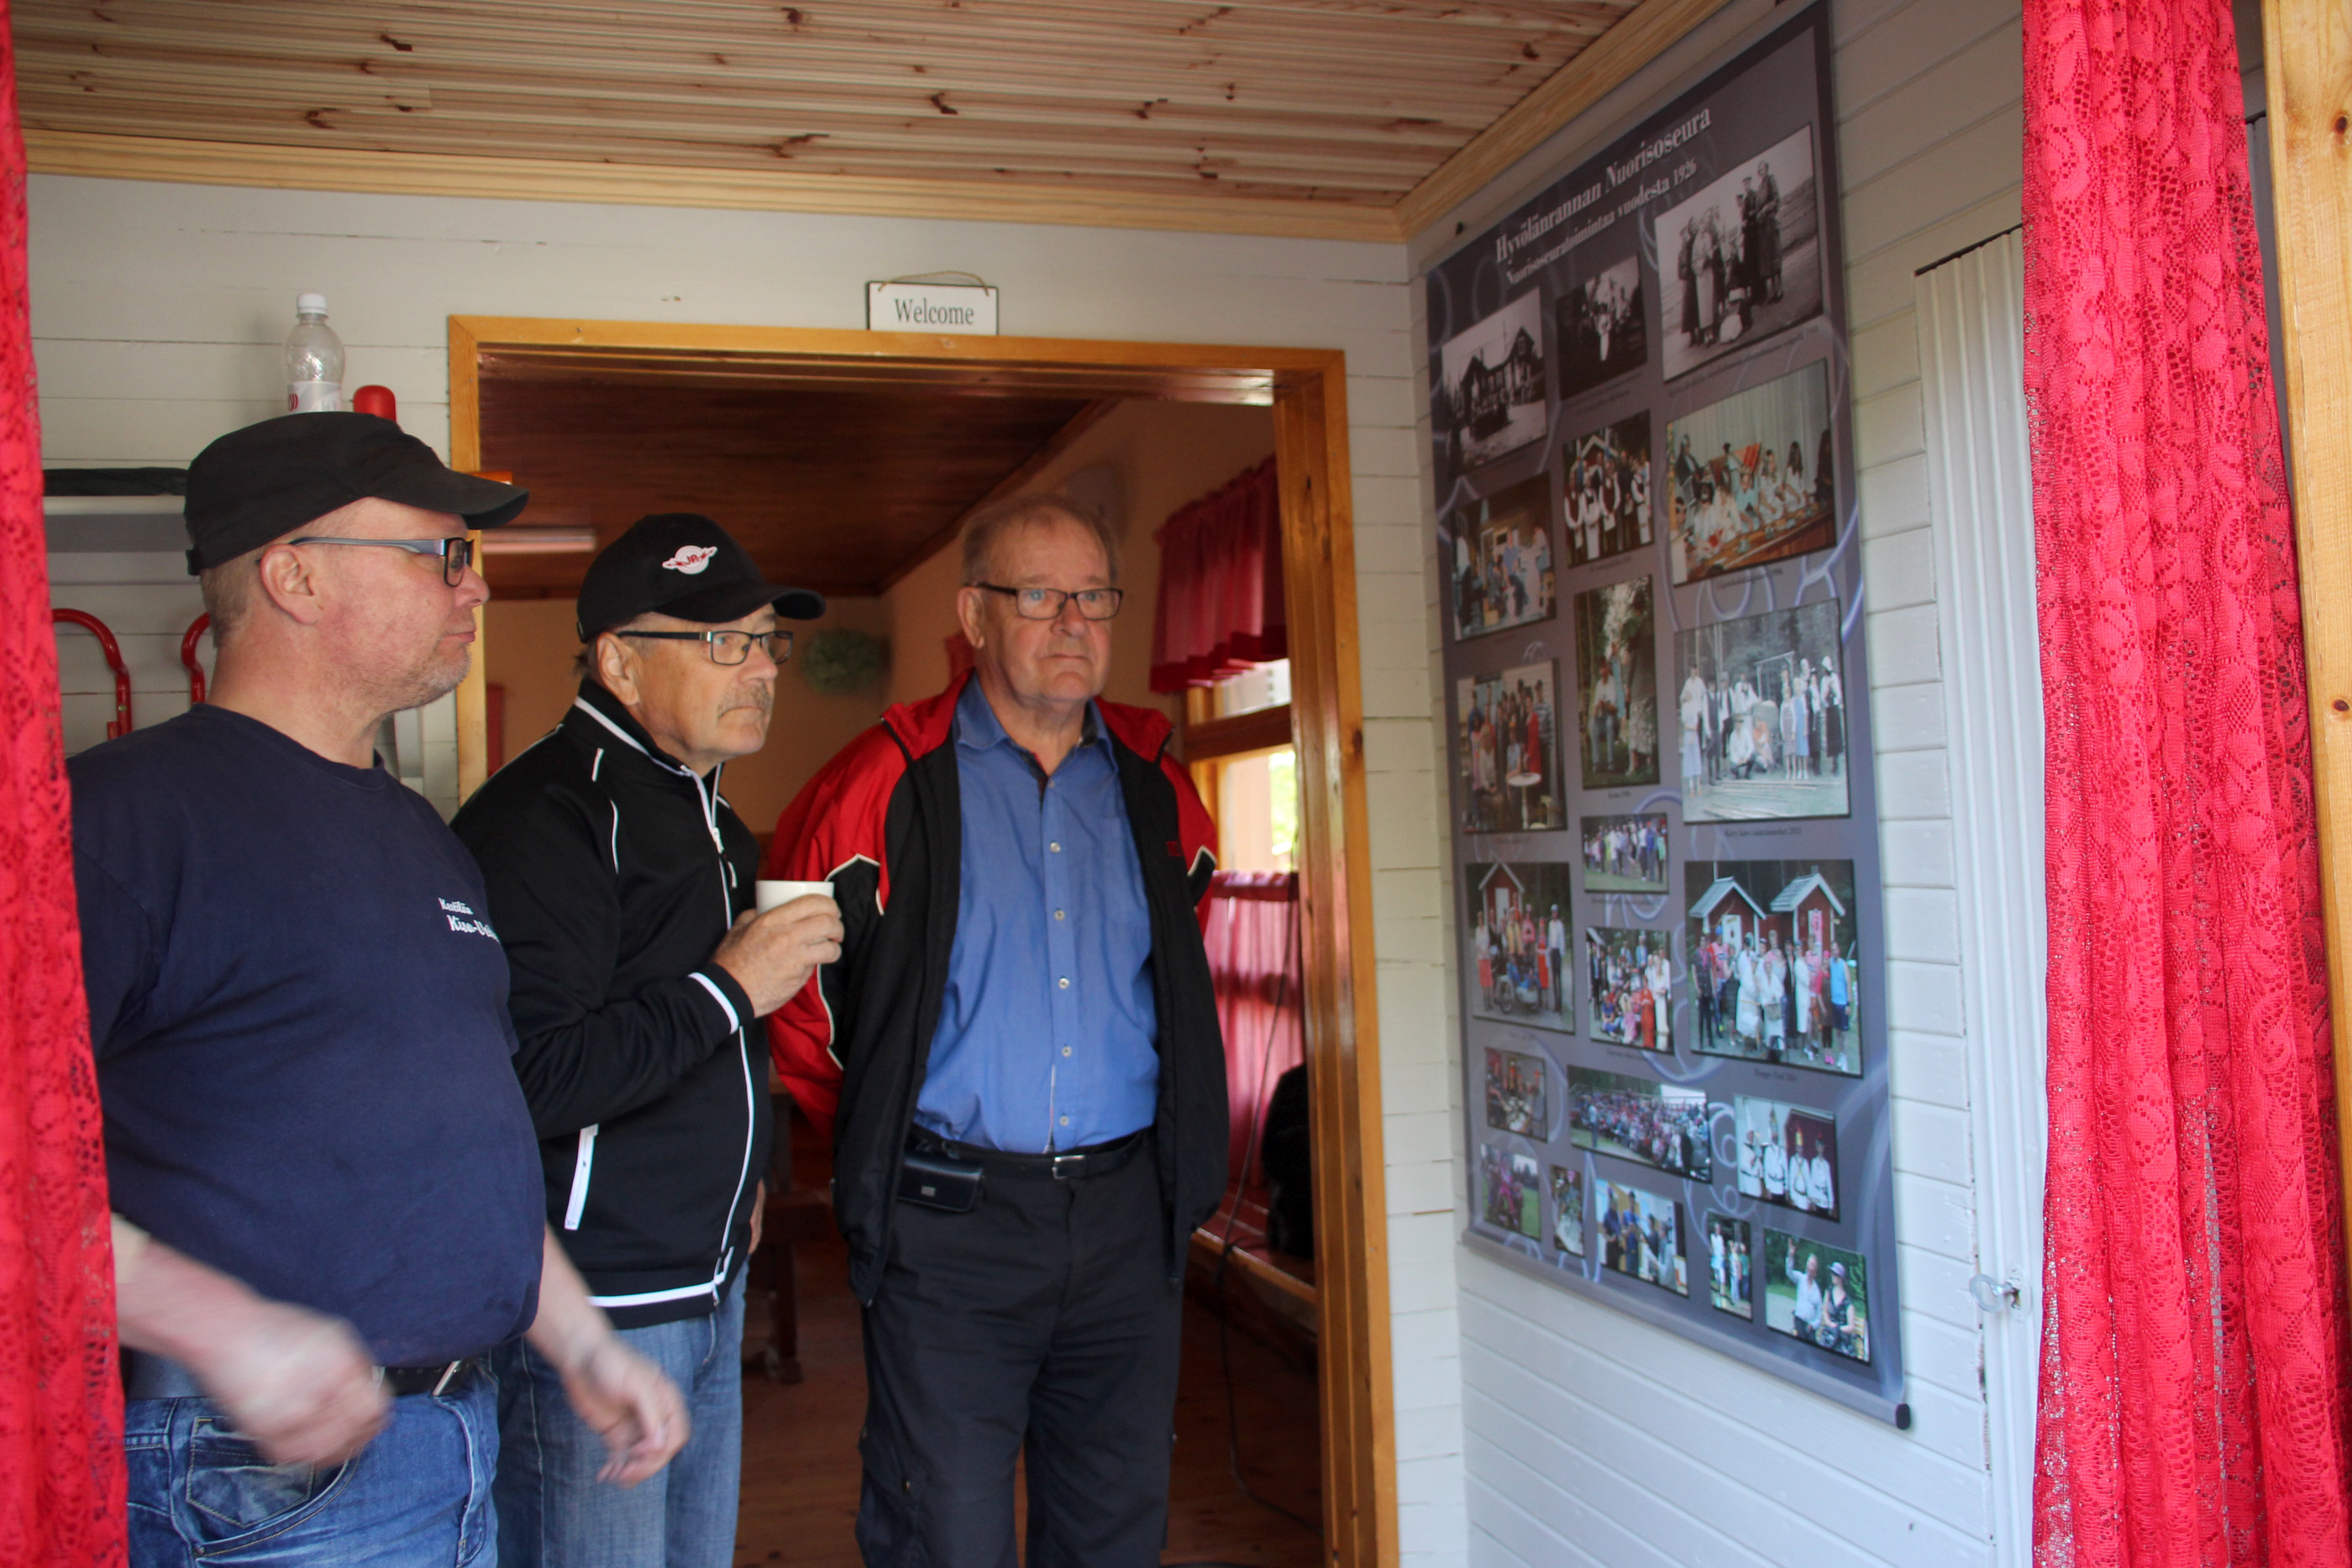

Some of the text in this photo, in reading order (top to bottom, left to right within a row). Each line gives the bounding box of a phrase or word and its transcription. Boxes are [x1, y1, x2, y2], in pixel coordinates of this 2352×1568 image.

[1496, 108, 1712, 265] Hyvölänrannan Nuorisoseura
[1618, 176, 1670, 218] vuodesta
[895, 297, 974, 324] Welcome
